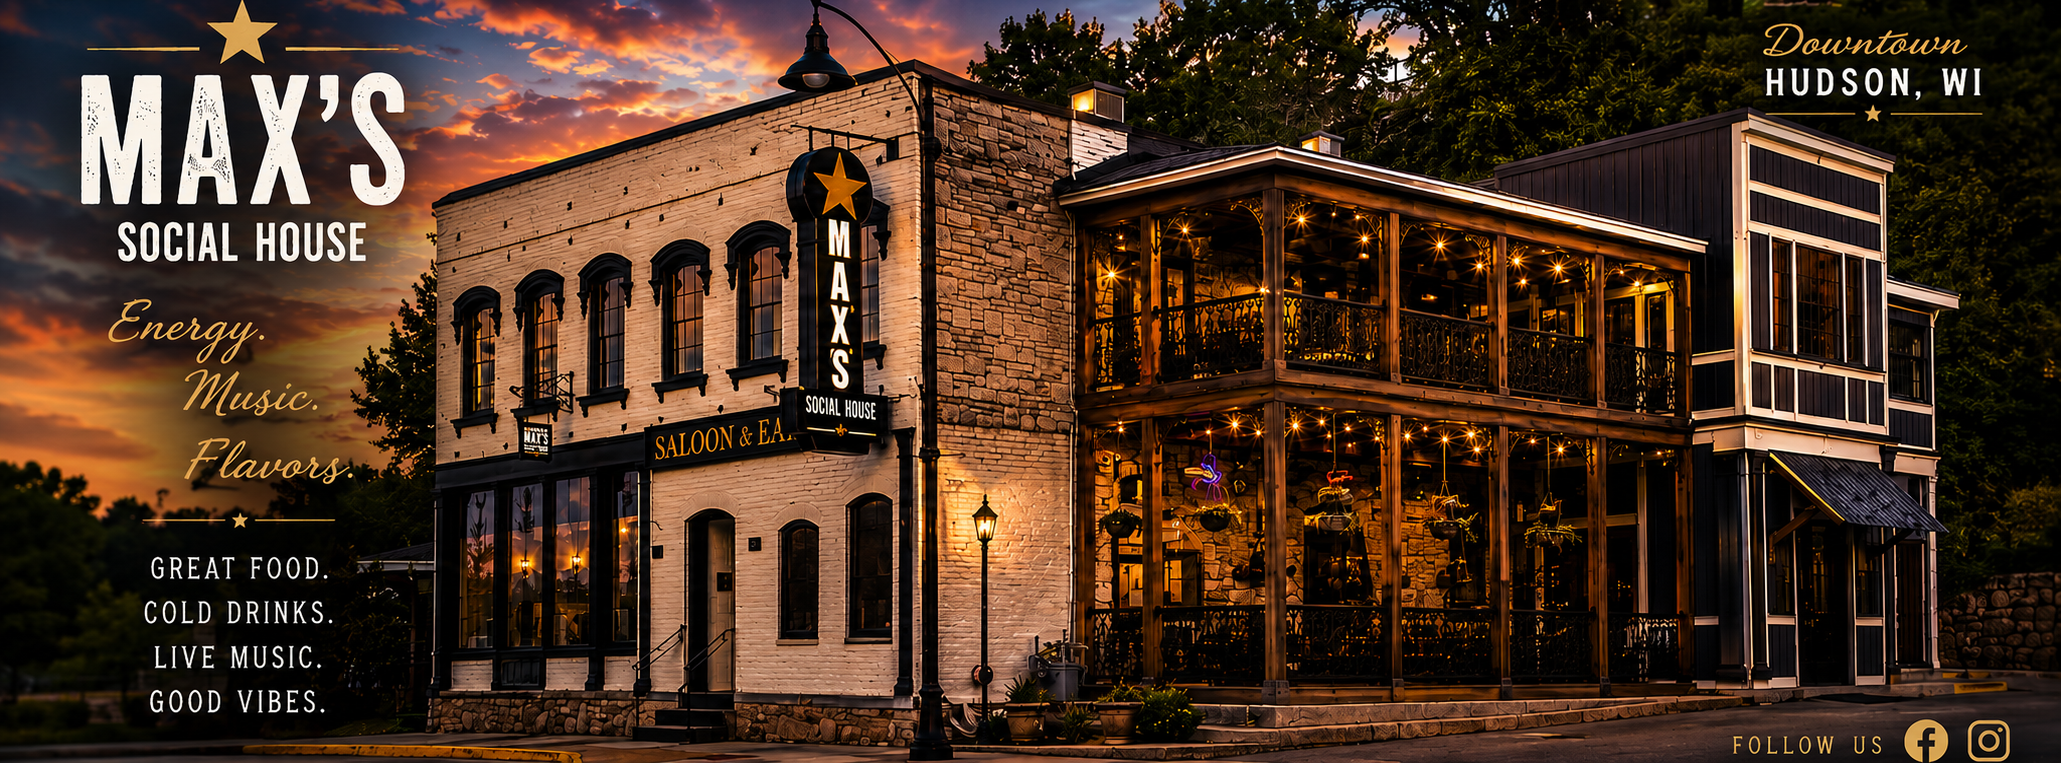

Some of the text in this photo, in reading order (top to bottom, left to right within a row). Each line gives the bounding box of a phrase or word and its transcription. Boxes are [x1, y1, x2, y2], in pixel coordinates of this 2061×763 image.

[806, 395, 876, 420] SOCIAL HOUSE
[654, 417, 797, 460] SALOON & EA
